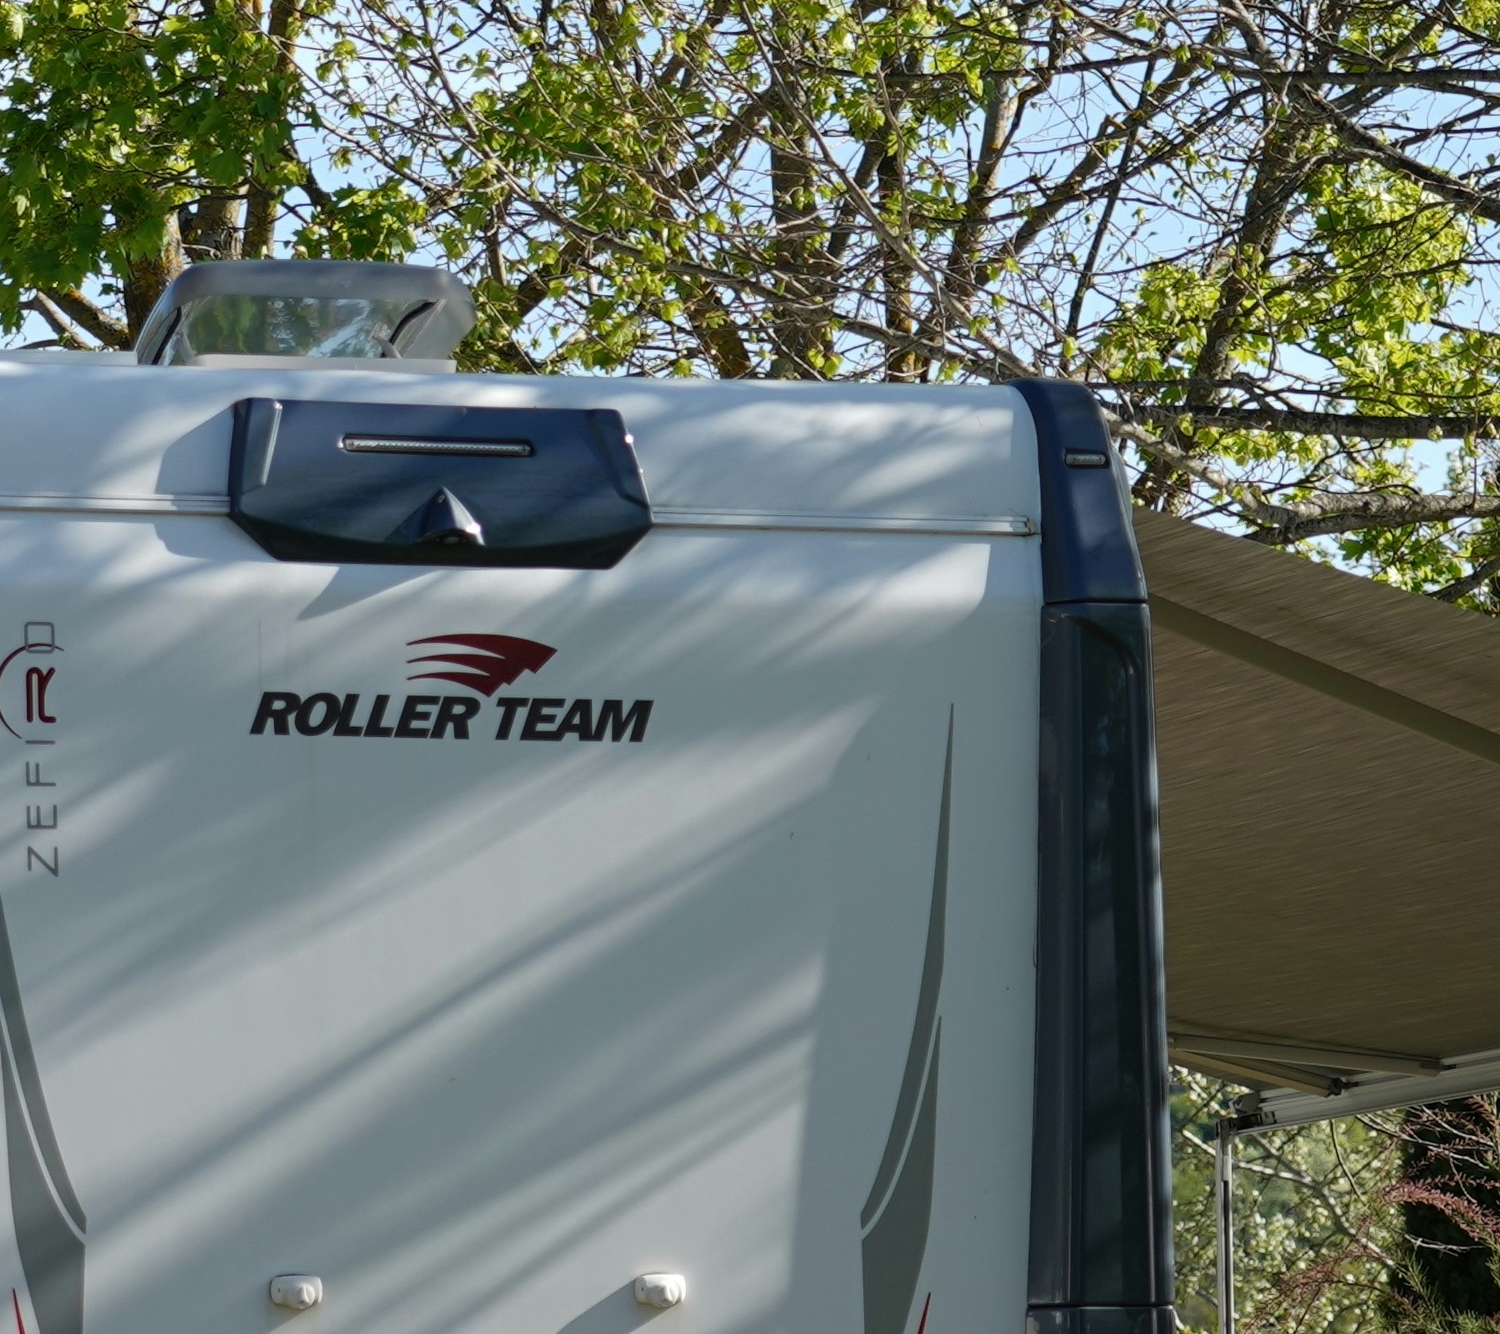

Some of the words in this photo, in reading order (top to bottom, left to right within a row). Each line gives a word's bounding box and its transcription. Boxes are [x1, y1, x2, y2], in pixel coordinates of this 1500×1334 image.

[22, 621, 61, 878] ZEFIRO
[249, 691, 481, 739] ROLLER
[495, 697, 655, 743] TEAM
